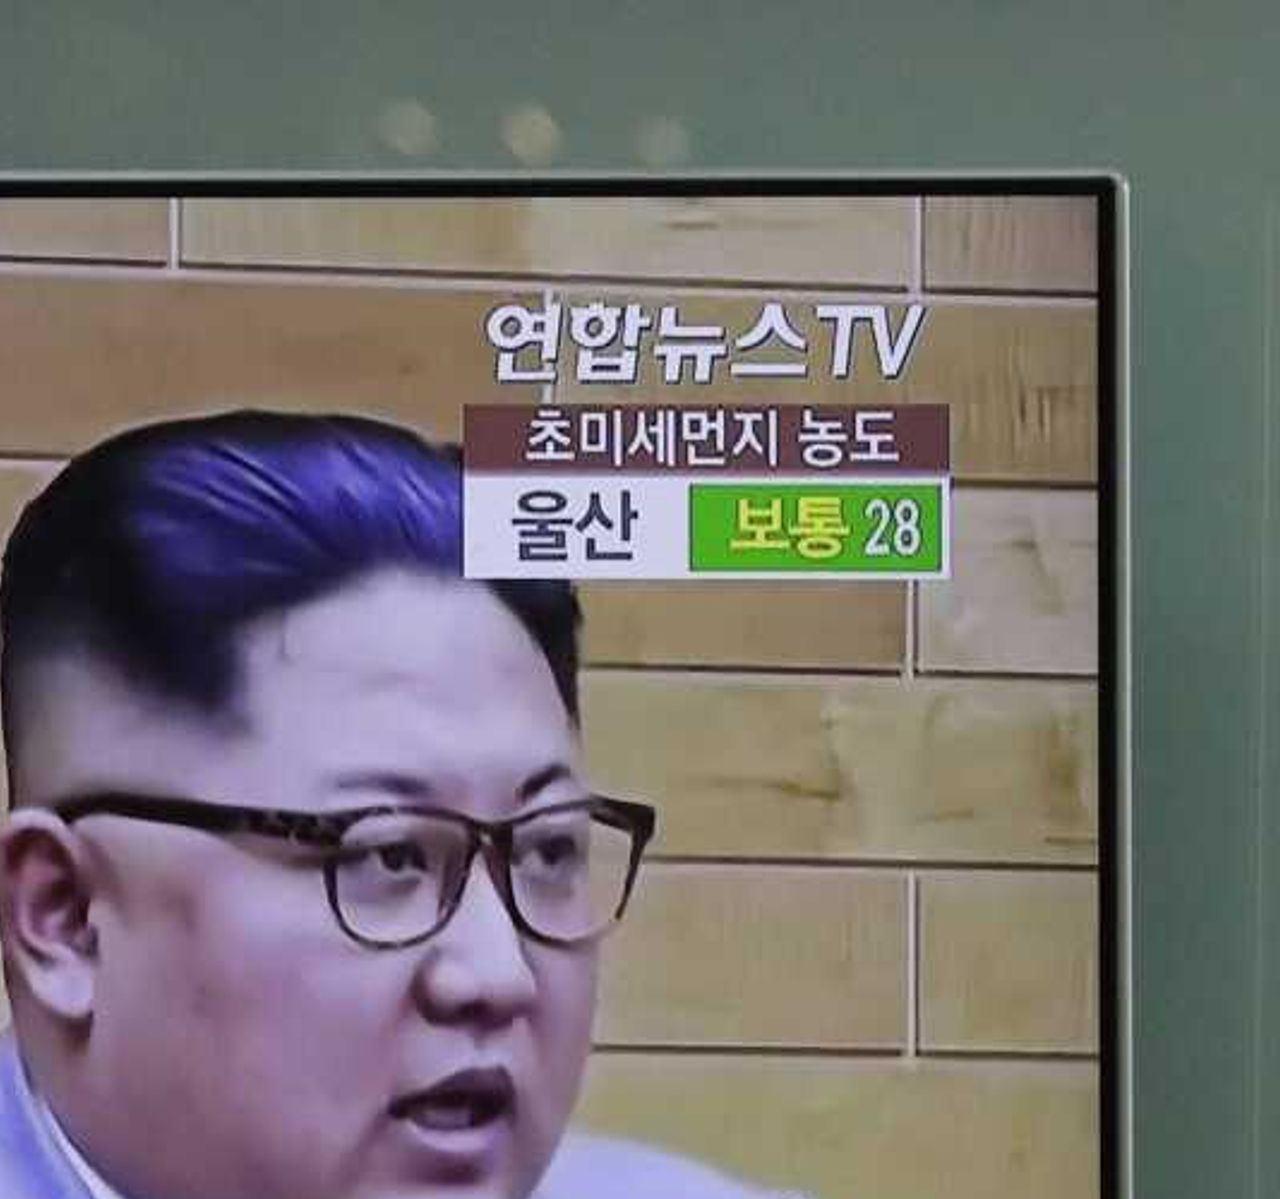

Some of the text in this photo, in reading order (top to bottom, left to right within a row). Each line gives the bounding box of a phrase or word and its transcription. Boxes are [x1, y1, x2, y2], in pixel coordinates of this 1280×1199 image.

[485, 302, 926, 383] 연합뉴스TV
[525, 409, 900, 467] 초미세먼지 농도
[511, 490, 639, 562] 울산
[731, 497, 920, 558] 보통 28
